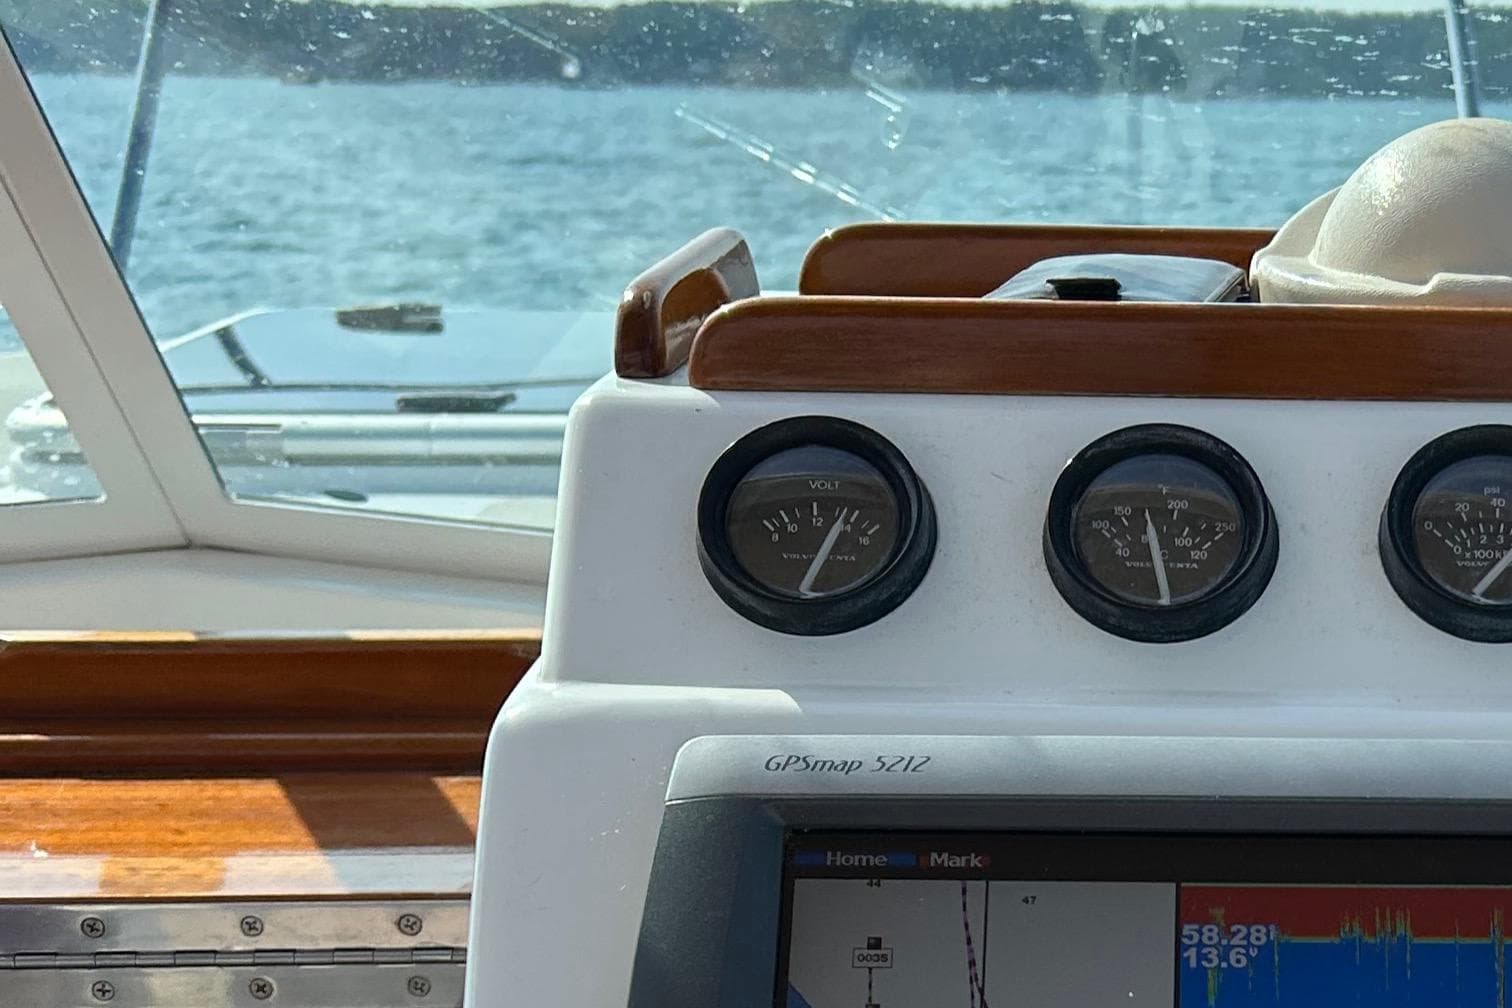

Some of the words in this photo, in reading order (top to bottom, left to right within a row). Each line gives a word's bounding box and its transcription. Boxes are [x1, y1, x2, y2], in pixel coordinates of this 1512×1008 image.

[808, 479, 840, 490] VOLT
[1484, 486, 1500, 496] psi
[1167, 500, 1189, 510] 200
[1455, 502, 1470, 513] 20
[1490, 498, 1506, 508] 40
[1113, 506, 1132, 516] 150
[812, 517, 824, 527] 12
[1092, 520, 1110, 530] 100
[1215, 522, 1236, 532] 250
[1424, 521, 1433, 531] 0
[858, 535, 870, 546] 16
[1174, 537, 1193, 547] 100
[1479, 534, 1488, 545] 2
[1496, 534, 1505, 545] 3
[1115, 547, 1130, 558] 40
[1190, 550, 1208, 560] 120
[1453, 545, 1462, 555] 0
[764, 754, 863, 775] GPSmap
[870, 755, 931, 772] 5212
[826, 851, 888, 867] Home
[929, 851, 983, 868] Mark
